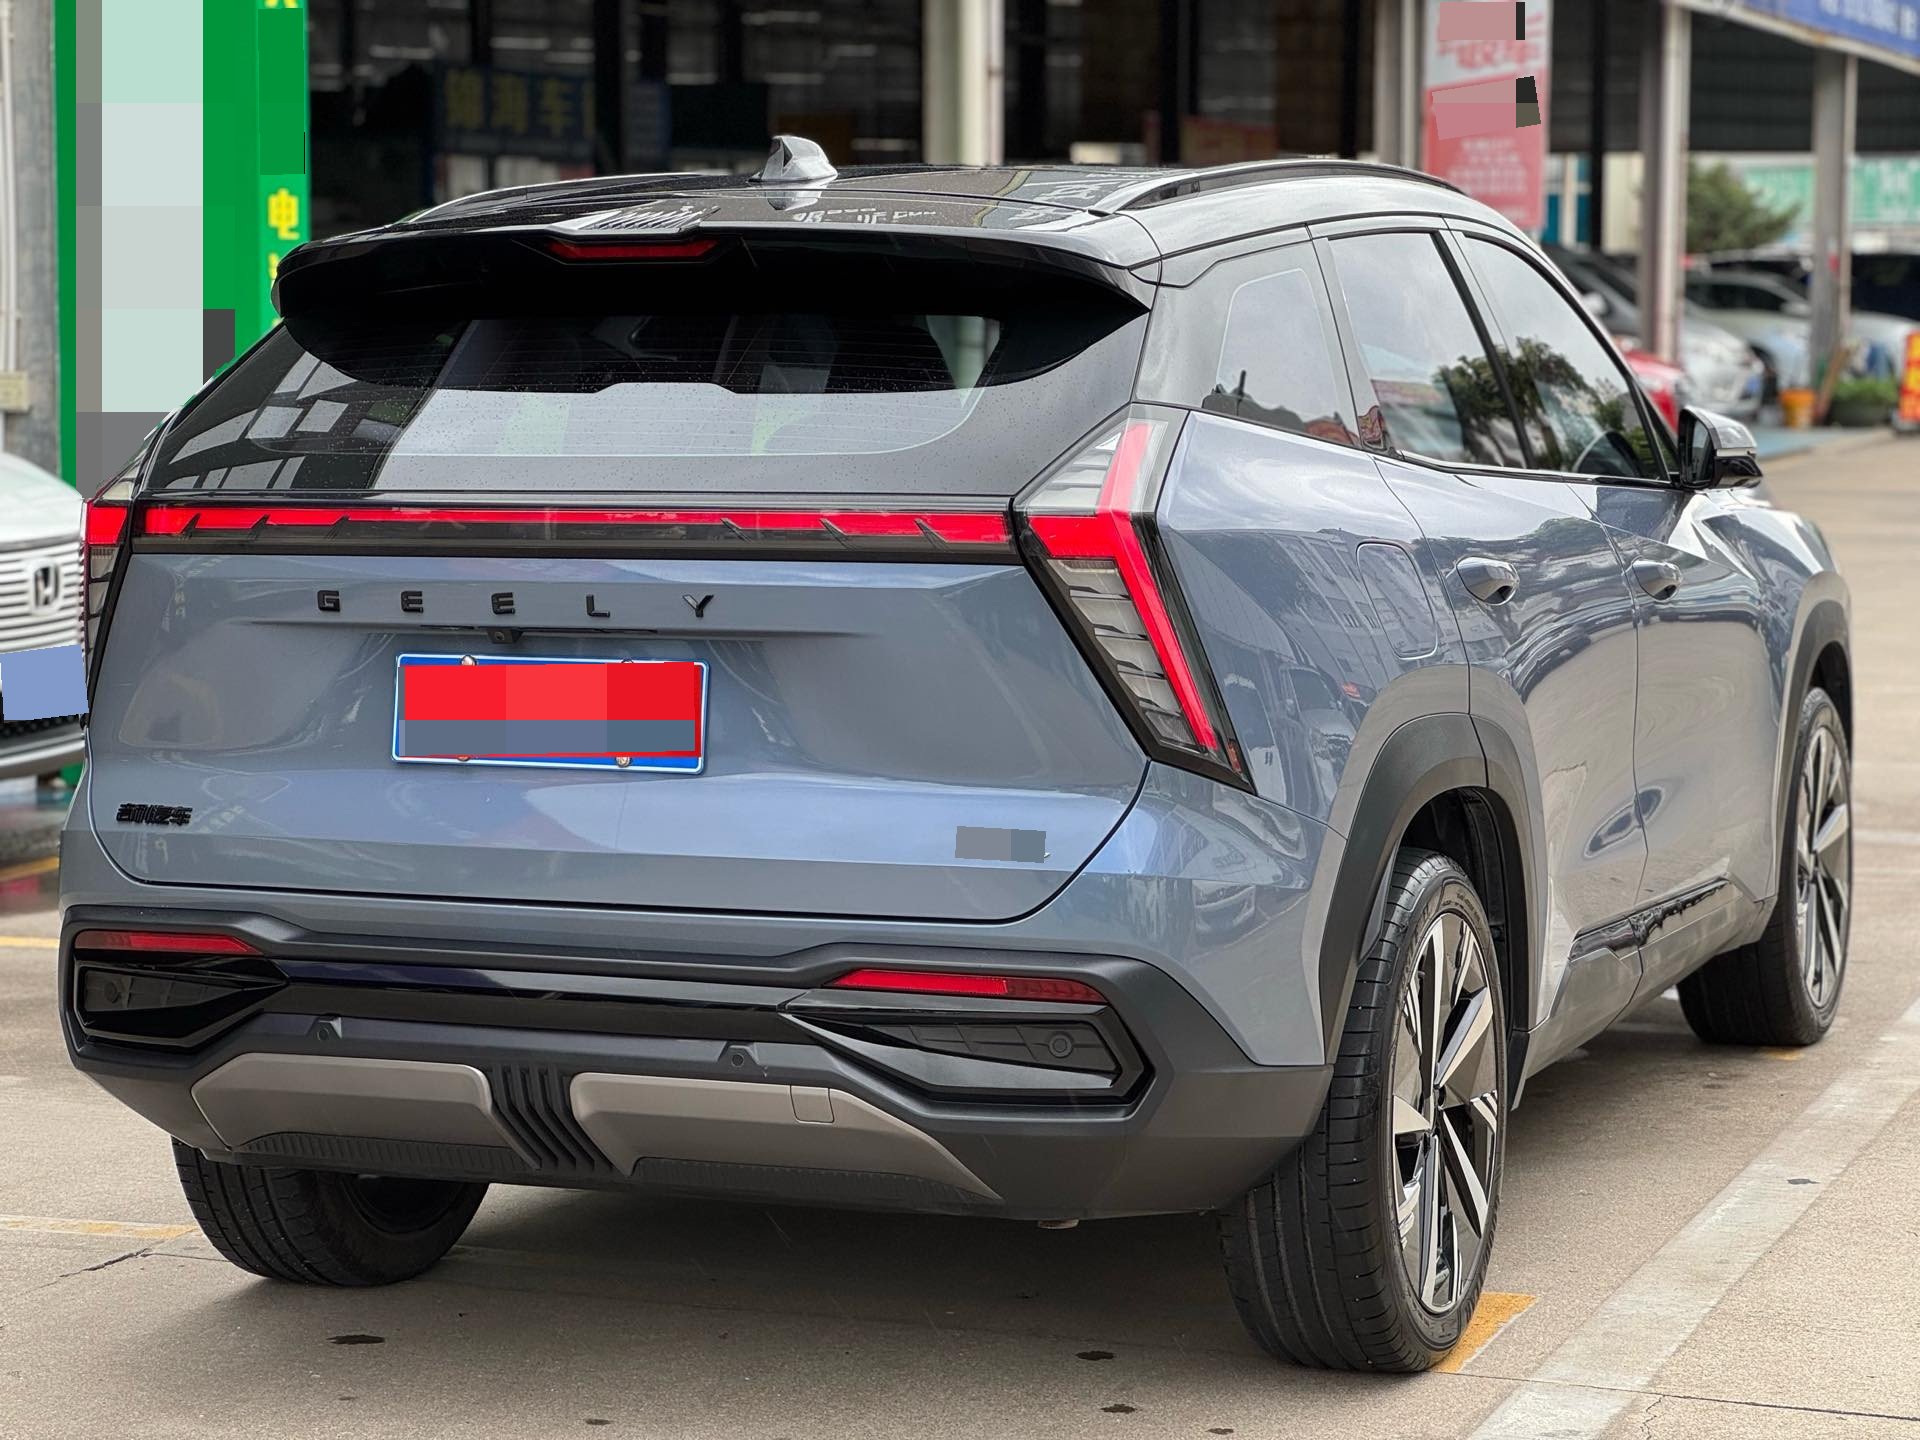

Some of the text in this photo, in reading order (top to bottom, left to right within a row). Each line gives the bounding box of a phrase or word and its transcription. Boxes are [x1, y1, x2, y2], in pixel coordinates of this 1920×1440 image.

[317, 590, 714, 618] GEELY
[116, 803, 193, 826] 吉利汽车
